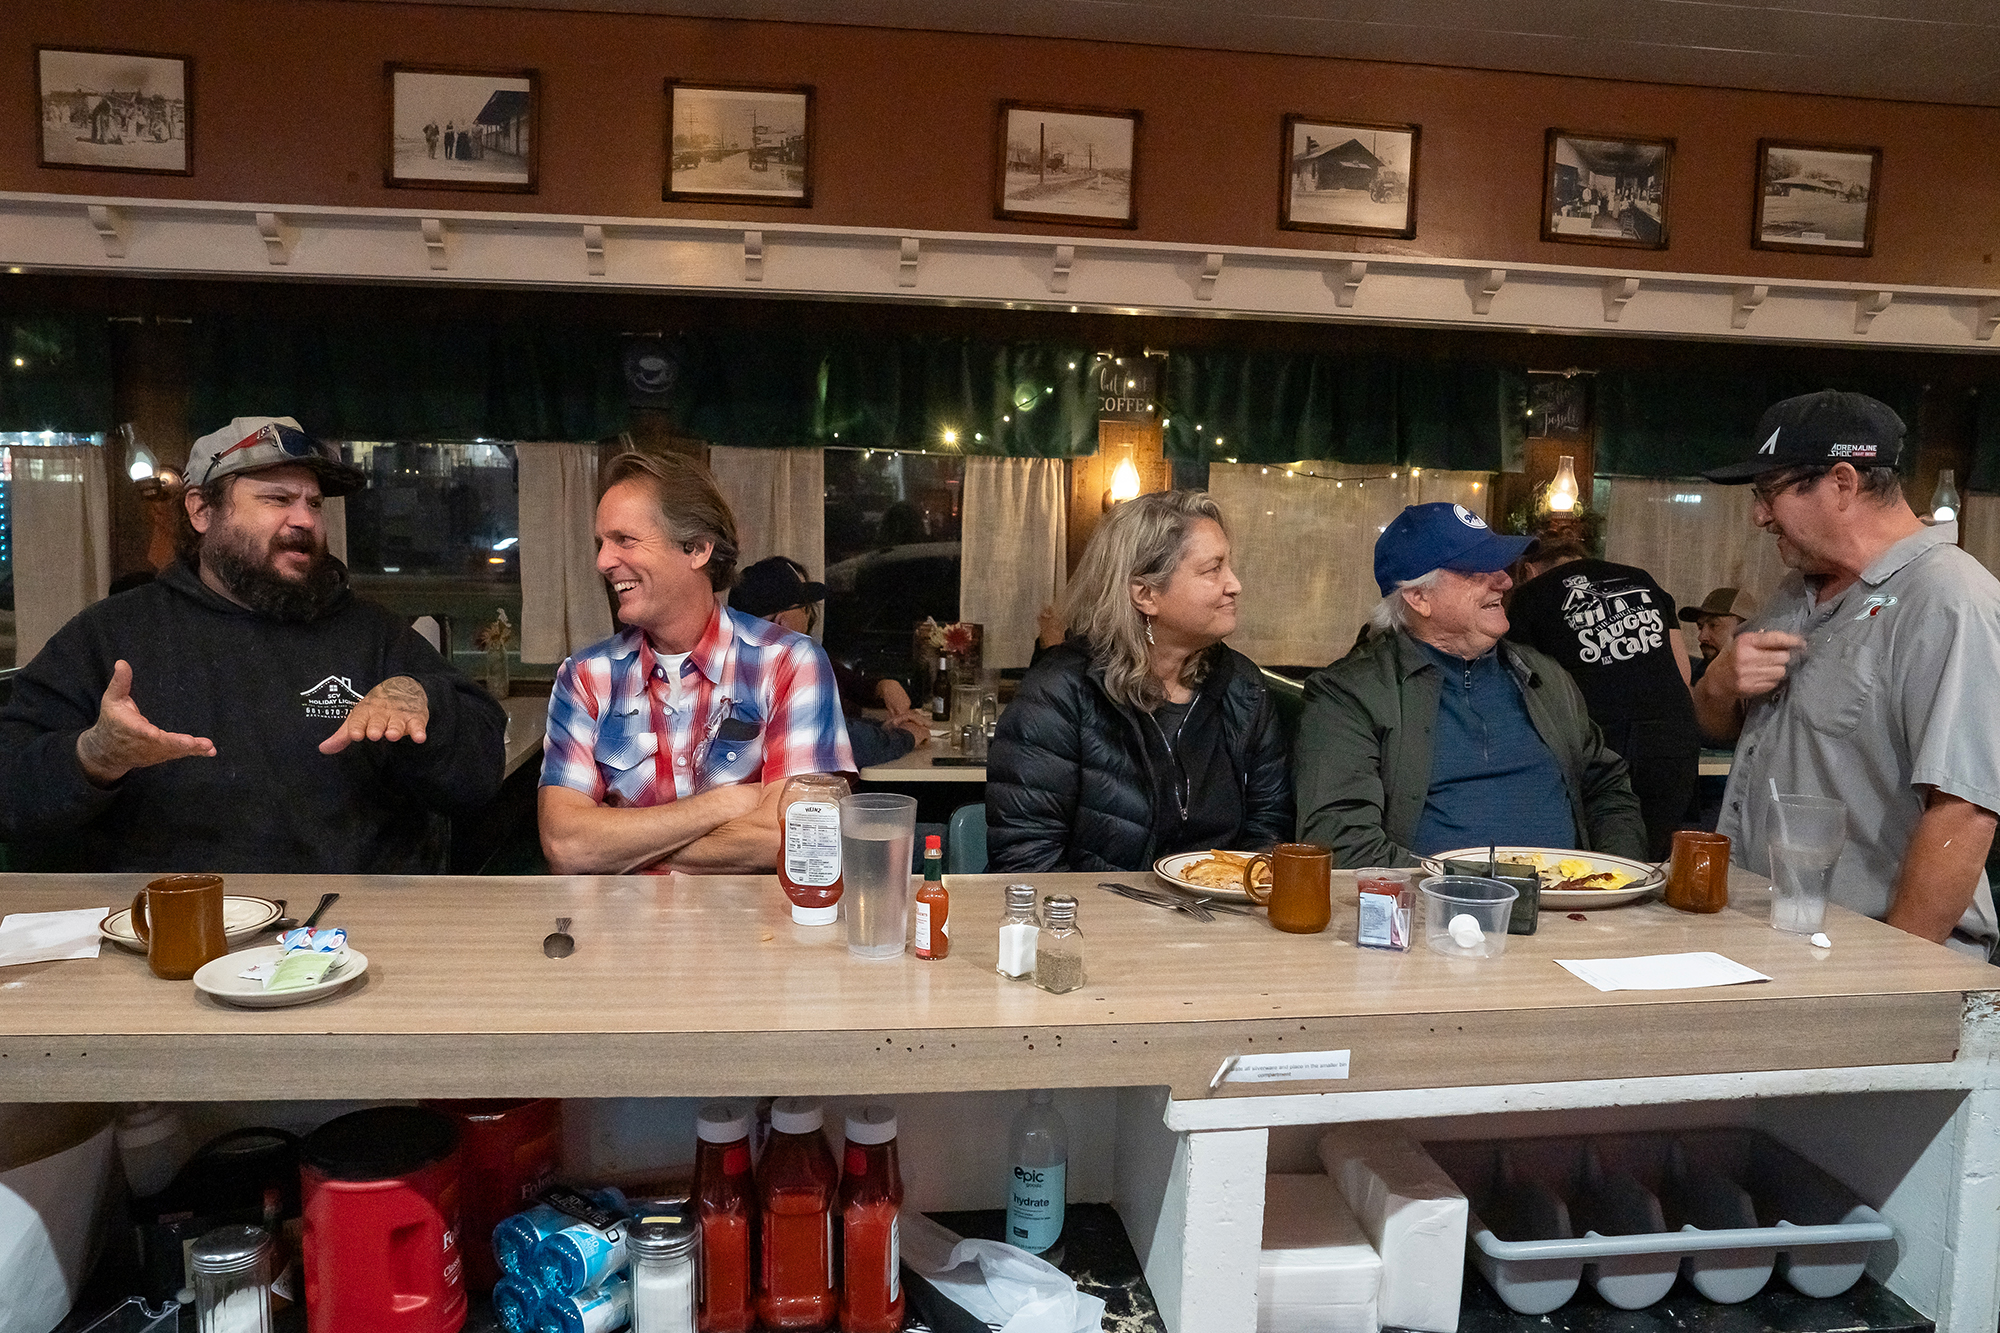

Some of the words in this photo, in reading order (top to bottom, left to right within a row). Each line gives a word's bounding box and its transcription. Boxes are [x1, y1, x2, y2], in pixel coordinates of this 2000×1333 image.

[1830, 443, 1877, 451] ADRENALINE
[1594, 620, 1611, 633] THE
[1609, 604, 1647, 622] ORIGINAL
[1609, 626, 1663, 661] Cafe
[1014, 1166, 1044, 1183] epic
[1013, 1192, 1050, 1208] hydrate
